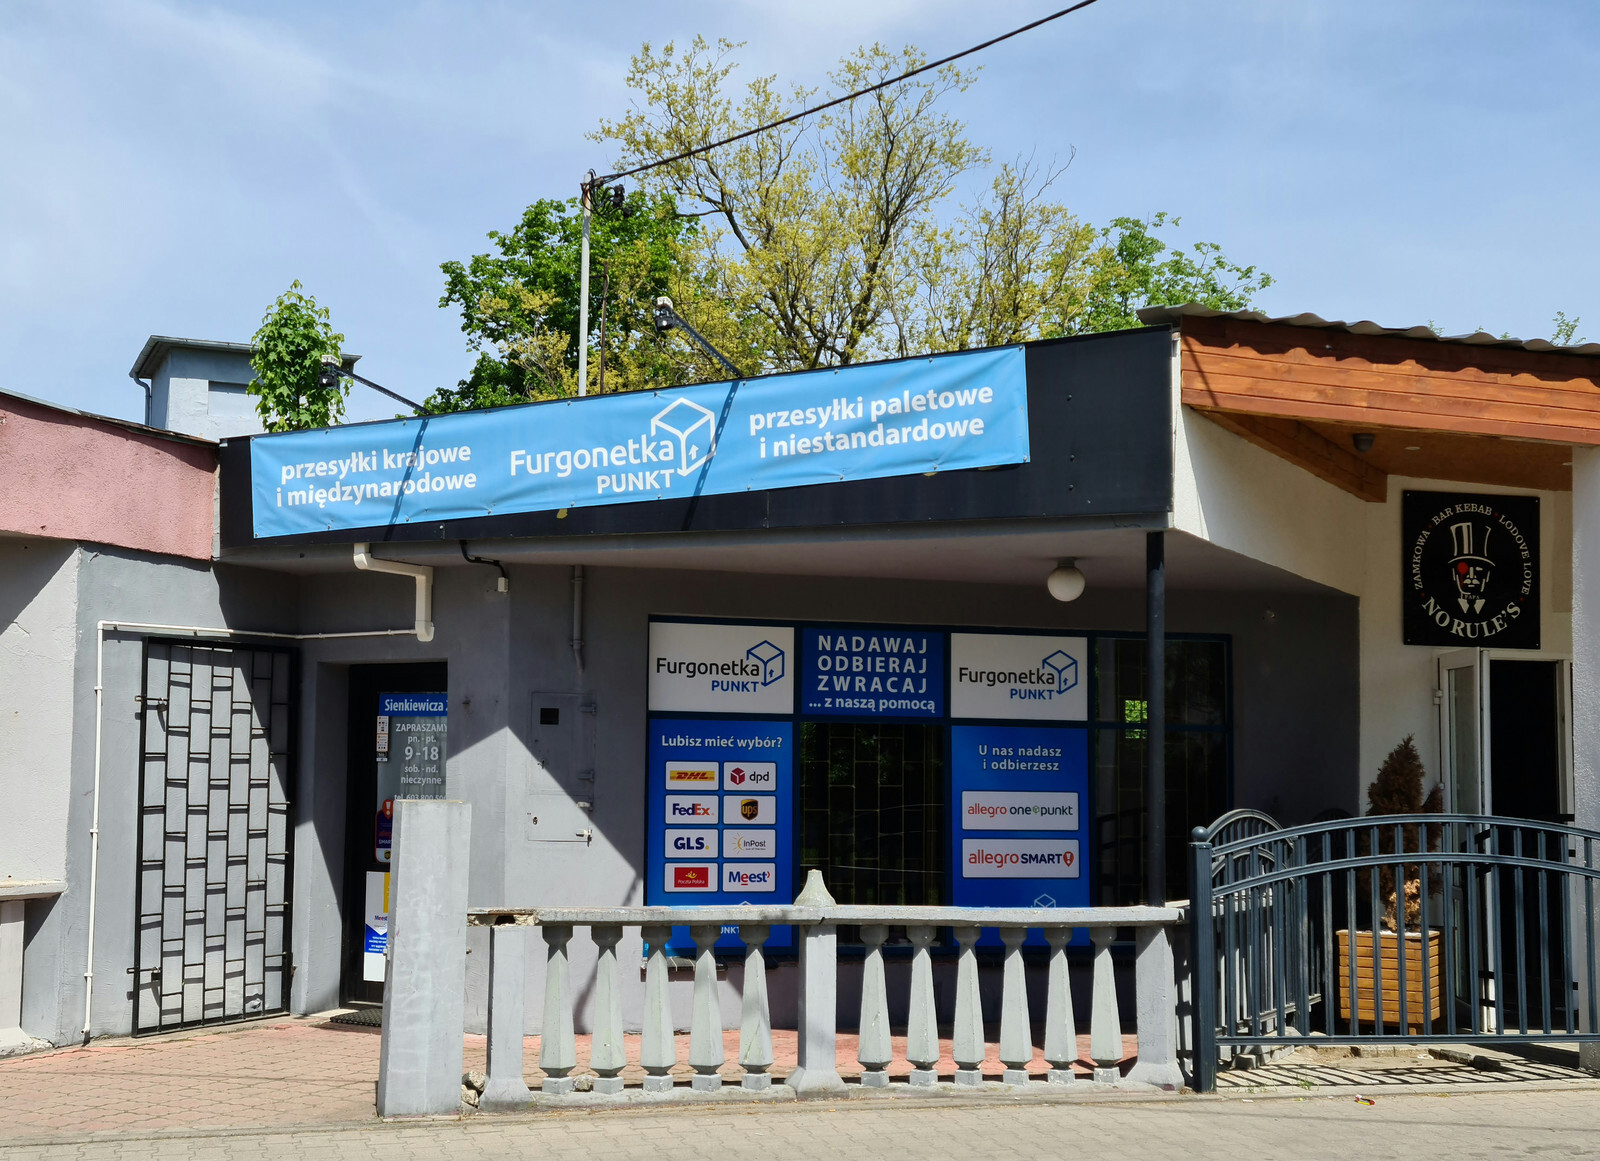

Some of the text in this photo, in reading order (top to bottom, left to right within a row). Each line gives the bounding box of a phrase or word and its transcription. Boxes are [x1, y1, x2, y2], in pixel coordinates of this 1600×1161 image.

[749, 386, 994, 436] przesyłki paletowe
[760, 417, 985, 459] i niestandardowe
[510, 434, 675, 477] Furgonetka
[281, 445, 472, 485] przesyłki krajowe
[597, 468, 675, 494] PUNKT
[276, 472, 477, 509] i międzynarodowe
[1432, 503, 1493, 526] BAR KEBAB
[1412, 530, 1431, 590] ZAMKOWA
[1498, 514, 1533, 595] LODOVE LOVE
[818, 635, 927, 654] NADAWAJ
[656, 657, 760, 678] Furgonetka
[817, 655, 927, 674] ODBIERAJ
[817, 675, 927, 694] ZWRACAJ
[959, 667, 1055, 687] Furgonetka
[711, 680, 760, 693] PUNKT
[1010, 688, 1055, 700] PUNKT
[384, 699, 444, 711] Sienkiewicza
[824, 698, 832, 708] z
[835, 698, 876, 712] naszą
[879, 699, 936, 714] pomocą
[395, 723, 448, 732] ZAPRASZAMY
[407, 736, 420, 744] pn.
[425, 735, 437, 744] pt.
[661, 735, 783, 750] Lubisz mieć wybór?
[979, 745, 1062, 757] U nas nadasz
[404, 764, 420, 773] sob.
[425, 765, 439, 773] nd.
[983, 758, 1059, 771] i odbierzesz
[400, 775, 442, 786] nieczynne
[676, 772, 709, 780] DHL
[749, 771, 770, 783] dpd
[672, 803, 710, 816] FedEx
[742, 805, 758, 815] ups
[967, 803, 1073, 818] allegro one punkt
[743, 839, 766, 848] InPost
[968, 849, 1062, 868] allegro SMART
